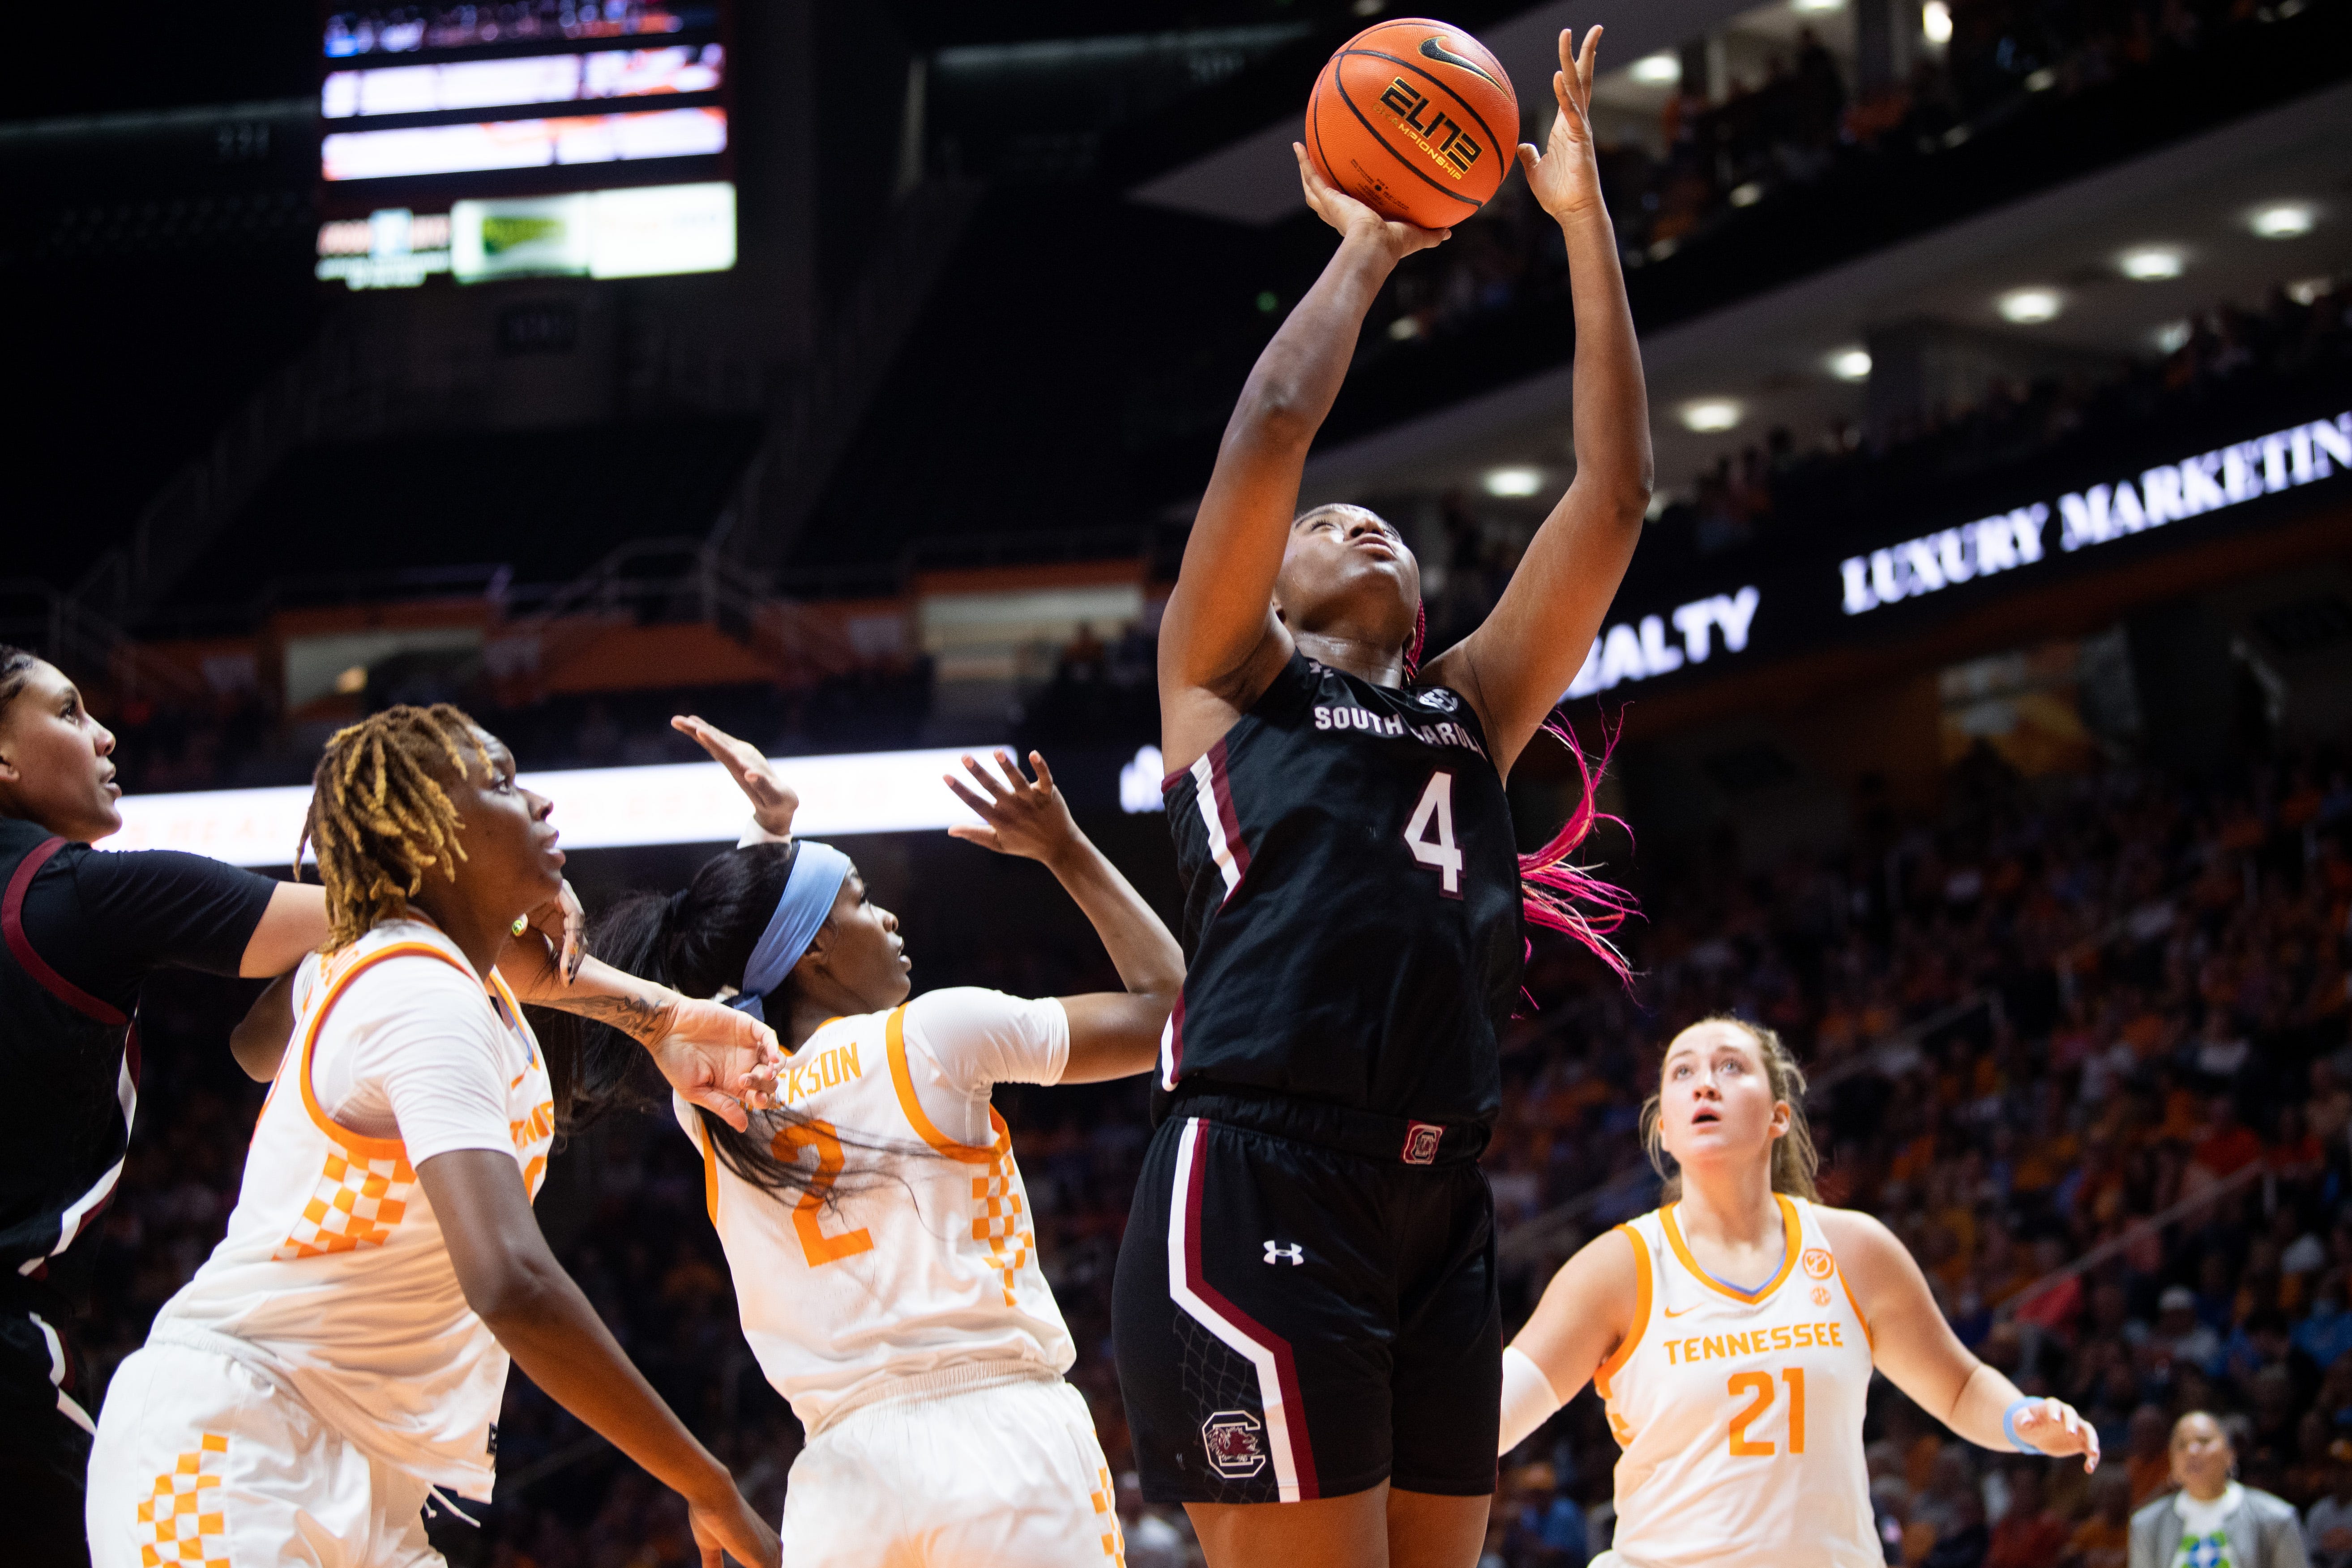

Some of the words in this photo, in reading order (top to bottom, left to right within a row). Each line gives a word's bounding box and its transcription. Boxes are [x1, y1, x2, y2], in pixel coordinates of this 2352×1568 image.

[1373, 103, 1462, 180] CHAMPIONSHIP
[1379, 76, 1484, 175] ELITE
[1839, 501, 2050, 615] LUXURY
[1314, 706, 1404, 735] SOUTH
[1403, 770, 1463, 894] 4
[770, 1119, 874, 1269] 2
[1663, 1321, 1844, 1366] TENNESSEE
[1727, 1367, 1805, 1457] 21
